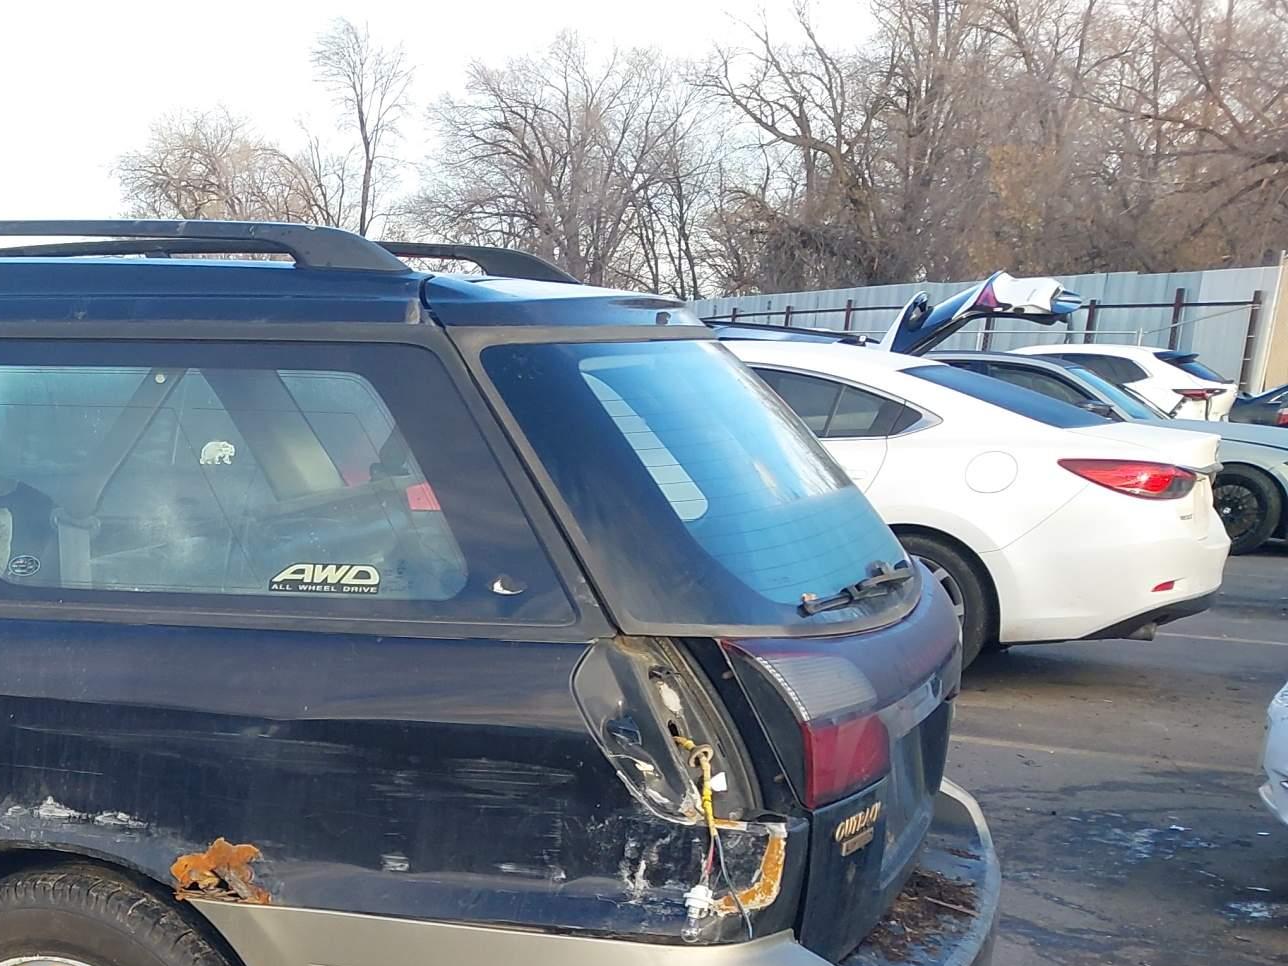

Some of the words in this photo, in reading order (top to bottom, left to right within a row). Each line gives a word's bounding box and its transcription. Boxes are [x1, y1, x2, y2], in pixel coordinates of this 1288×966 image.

[271, 563, 380, 585] AWD
[271, 583, 293, 591] ALL
[298, 584, 338, 592] WHEEL
[342, 585, 378, 593] DRIVE
